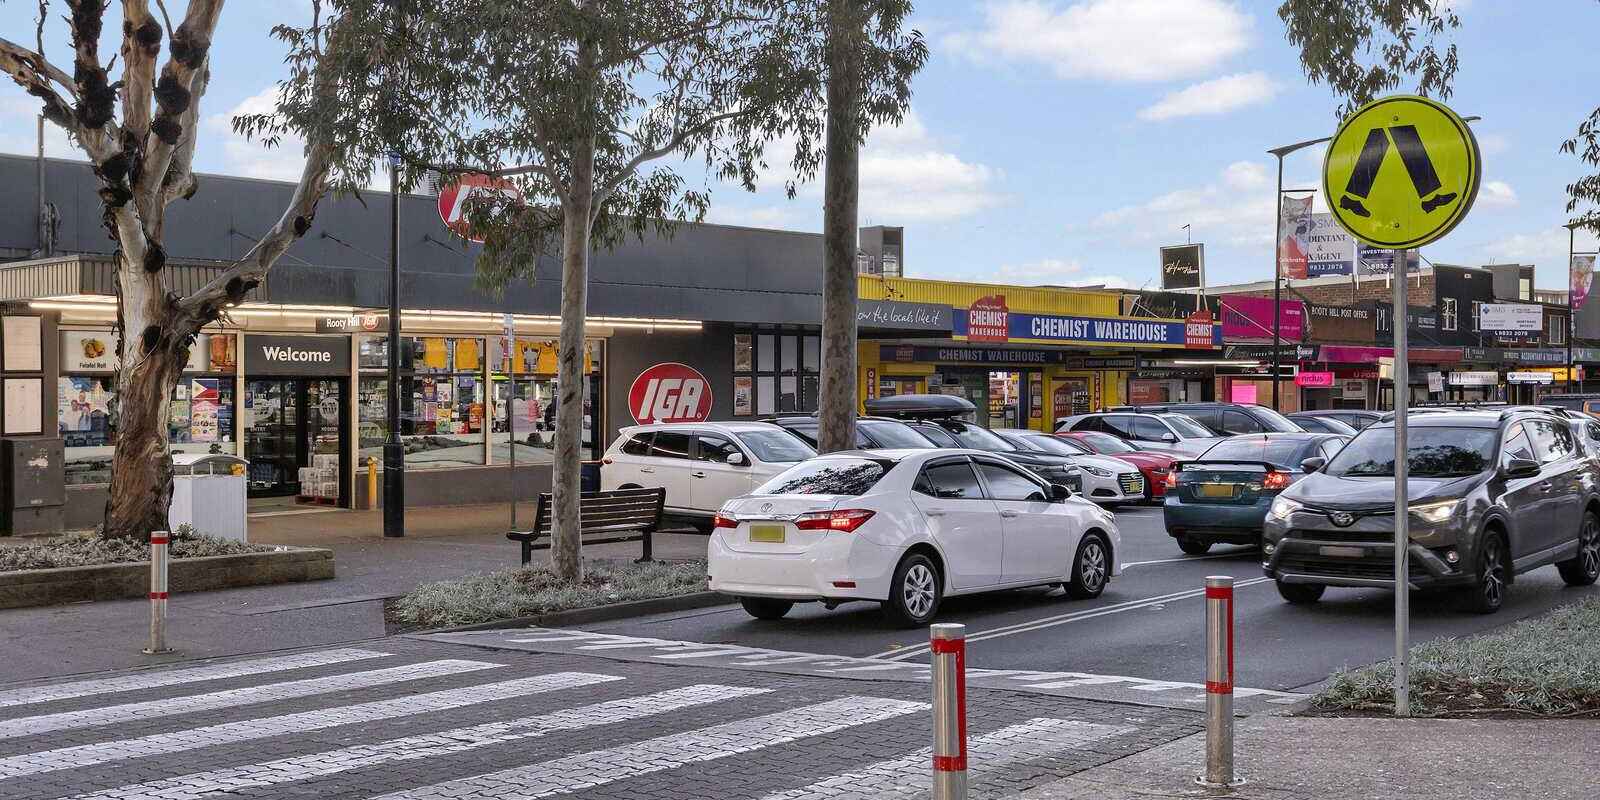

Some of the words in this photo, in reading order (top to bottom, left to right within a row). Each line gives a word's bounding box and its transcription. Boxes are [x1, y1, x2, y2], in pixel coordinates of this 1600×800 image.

[873, 305, 889, 323] the
[890, 305, 915, 323] locals
[915, 308, 931, 324] like
[969, 310, 1008, 327] CHEMIST
[1340, 308, 1352, 318] POST
[326, 318, 347, 330] Rooty
[347, 314, 361, 328] Hill
[1031, 316, 1090, 338] CHEMIST
[1094, 320, 1168, 342] WAREHOUSE
[1186, 322, 1213, 338] CHEMIST
[969, 327, 1007, 337] WAREHOUSE
[262, 346, 331, 362] Welcome
[939, 349, 983, 361] CHEMIST
[987, 351, 1046, 362] WAREHOUSE
[639, 378, 704, 420] IGA
